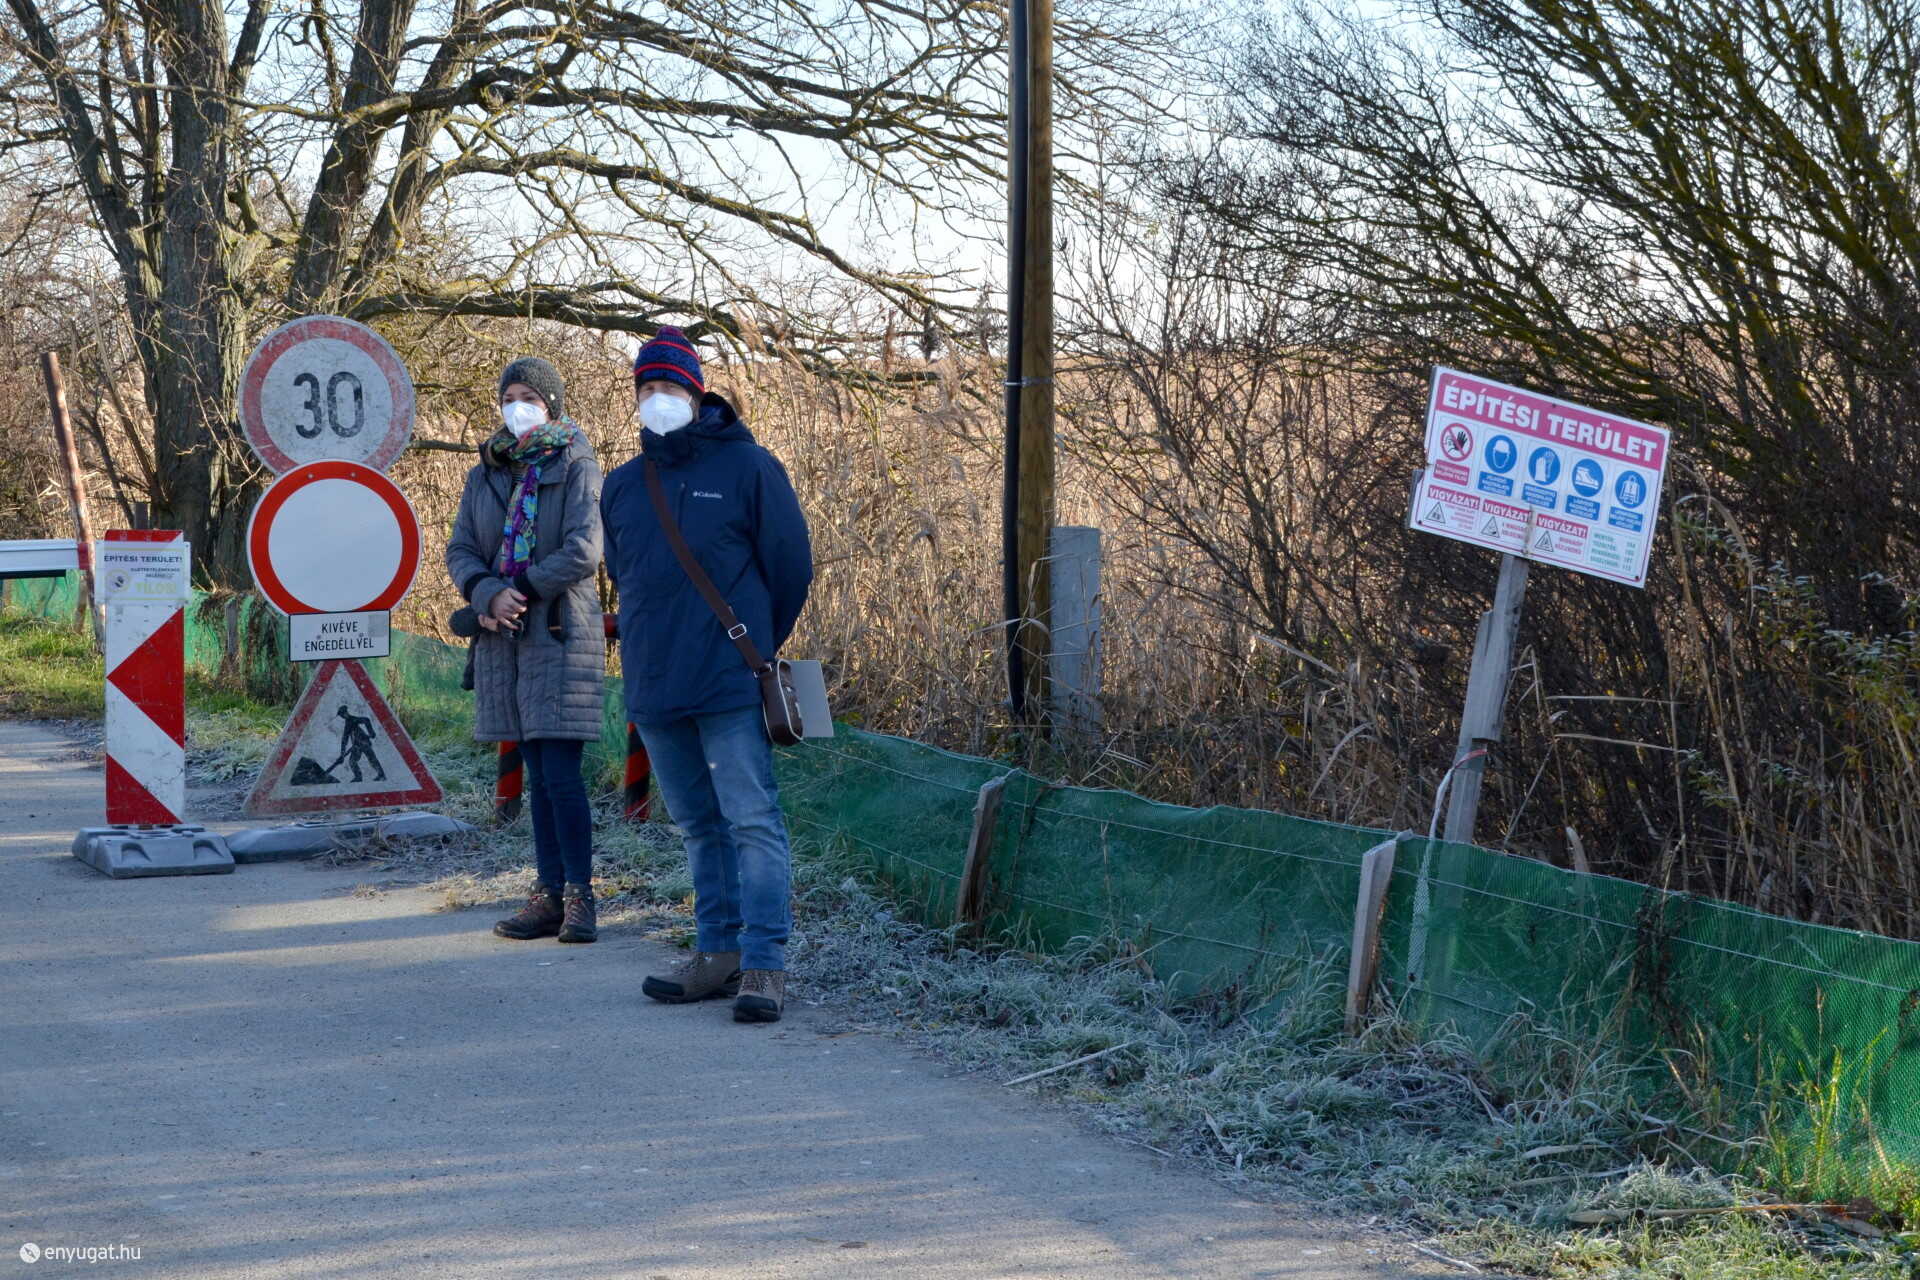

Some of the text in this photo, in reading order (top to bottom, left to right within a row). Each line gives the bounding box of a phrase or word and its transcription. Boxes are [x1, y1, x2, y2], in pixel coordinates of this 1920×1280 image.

[294, 371, 365, 439] 30
[1442, 382, 1657, 462] ÉPÍTÉSI TERÜLET
[1429, 486, 1479, 509] VIGYÁZAT!
[1538, 517, 1587, 538] VIGYÁZAT!
[321, 619, 359, 634] KIVÉVE
[304, 636, 375, 652] ENGEDÉLLYEL
